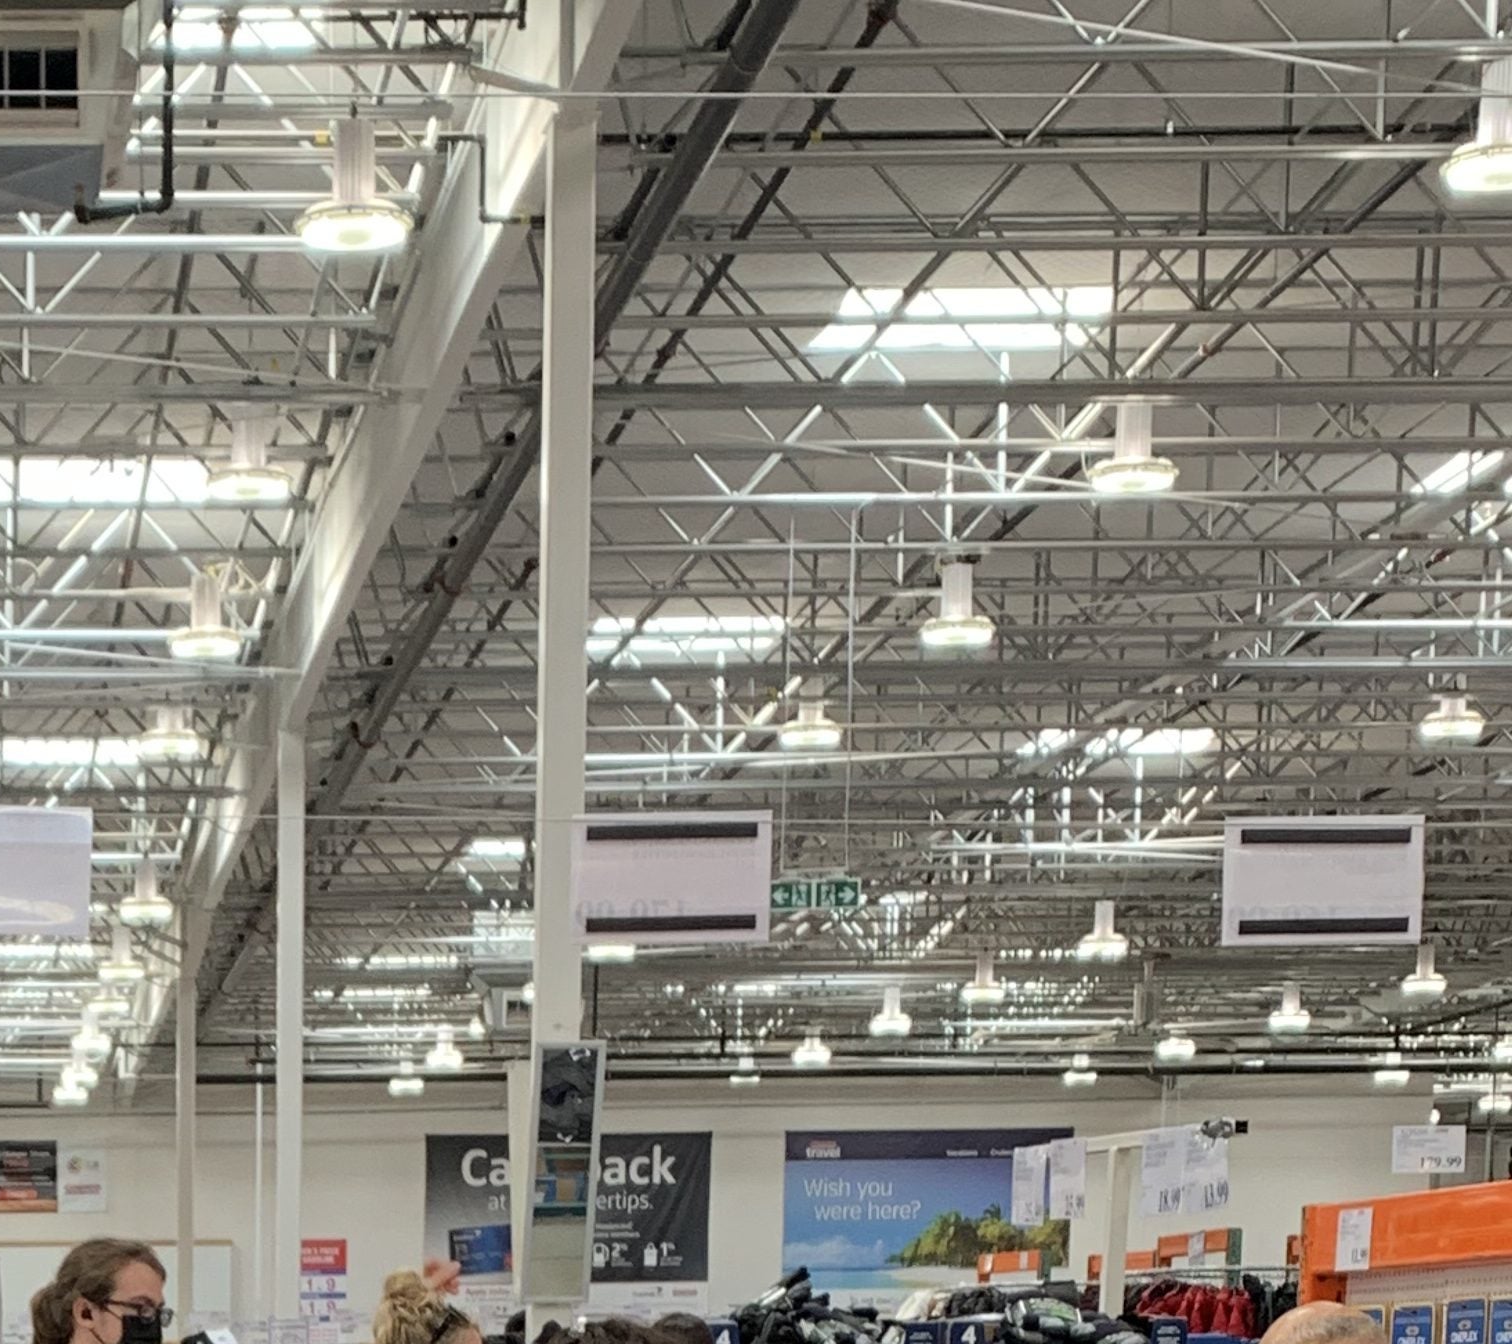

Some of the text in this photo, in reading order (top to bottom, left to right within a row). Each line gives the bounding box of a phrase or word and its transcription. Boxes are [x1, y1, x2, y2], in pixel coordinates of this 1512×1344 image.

[804, 1179, 892, 1201] Wish you
[488, 1190, 654, 1214] at ertips.
[814, 1201, 920, 1221] were here?
[961, 1325, 976, 1344] 4
